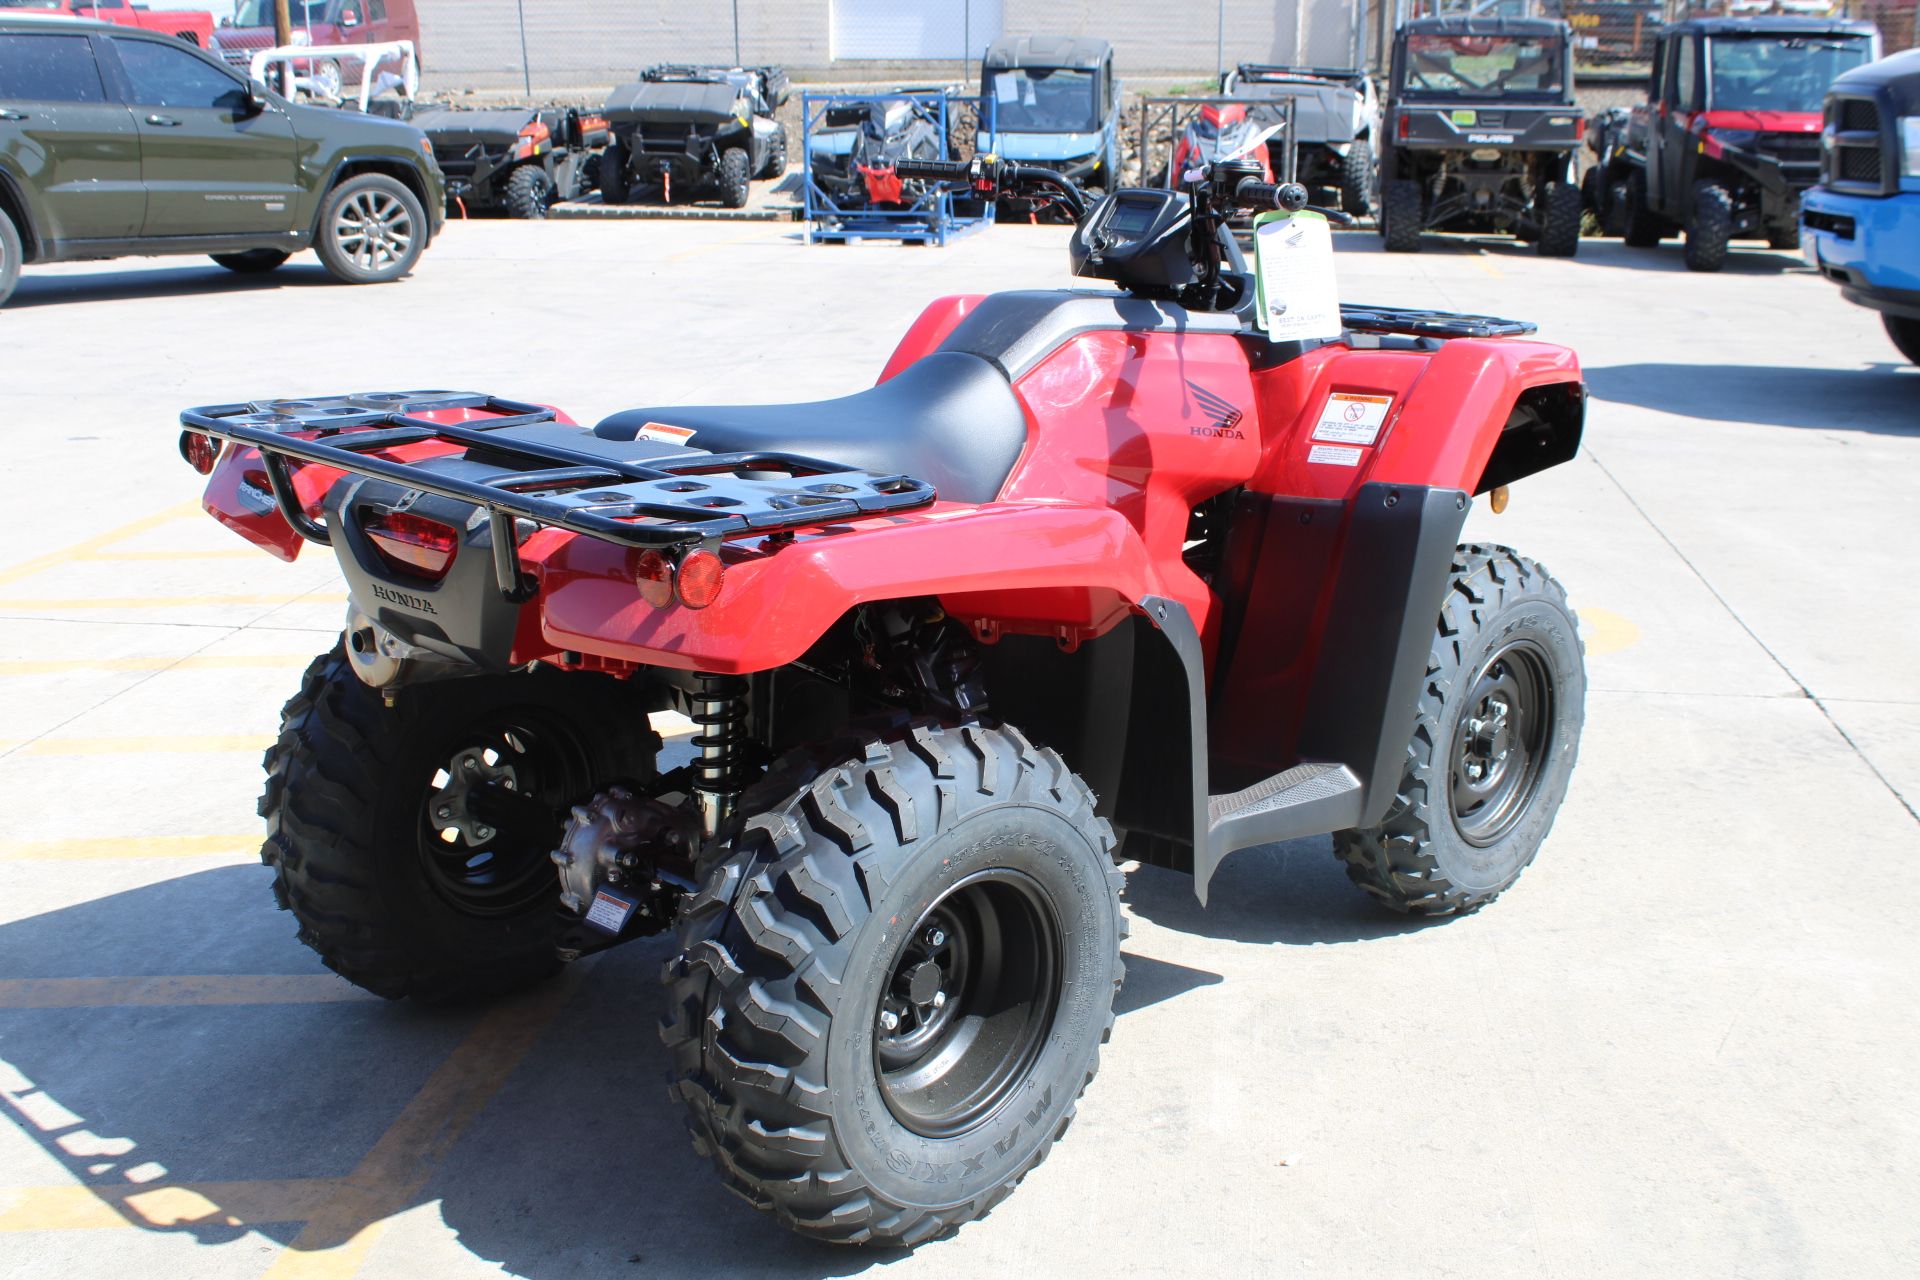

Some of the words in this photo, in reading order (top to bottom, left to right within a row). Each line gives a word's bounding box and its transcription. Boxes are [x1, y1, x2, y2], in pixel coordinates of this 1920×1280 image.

[1468, 133, 1514, 144] POLARIS
[1190, 426, 1245, 440] HONDA
[239, 481, 276, 508] RANCHER
[372, 583, 438, 615] HONDA
[886, 1083, 1052, 1184] MAXXIS
